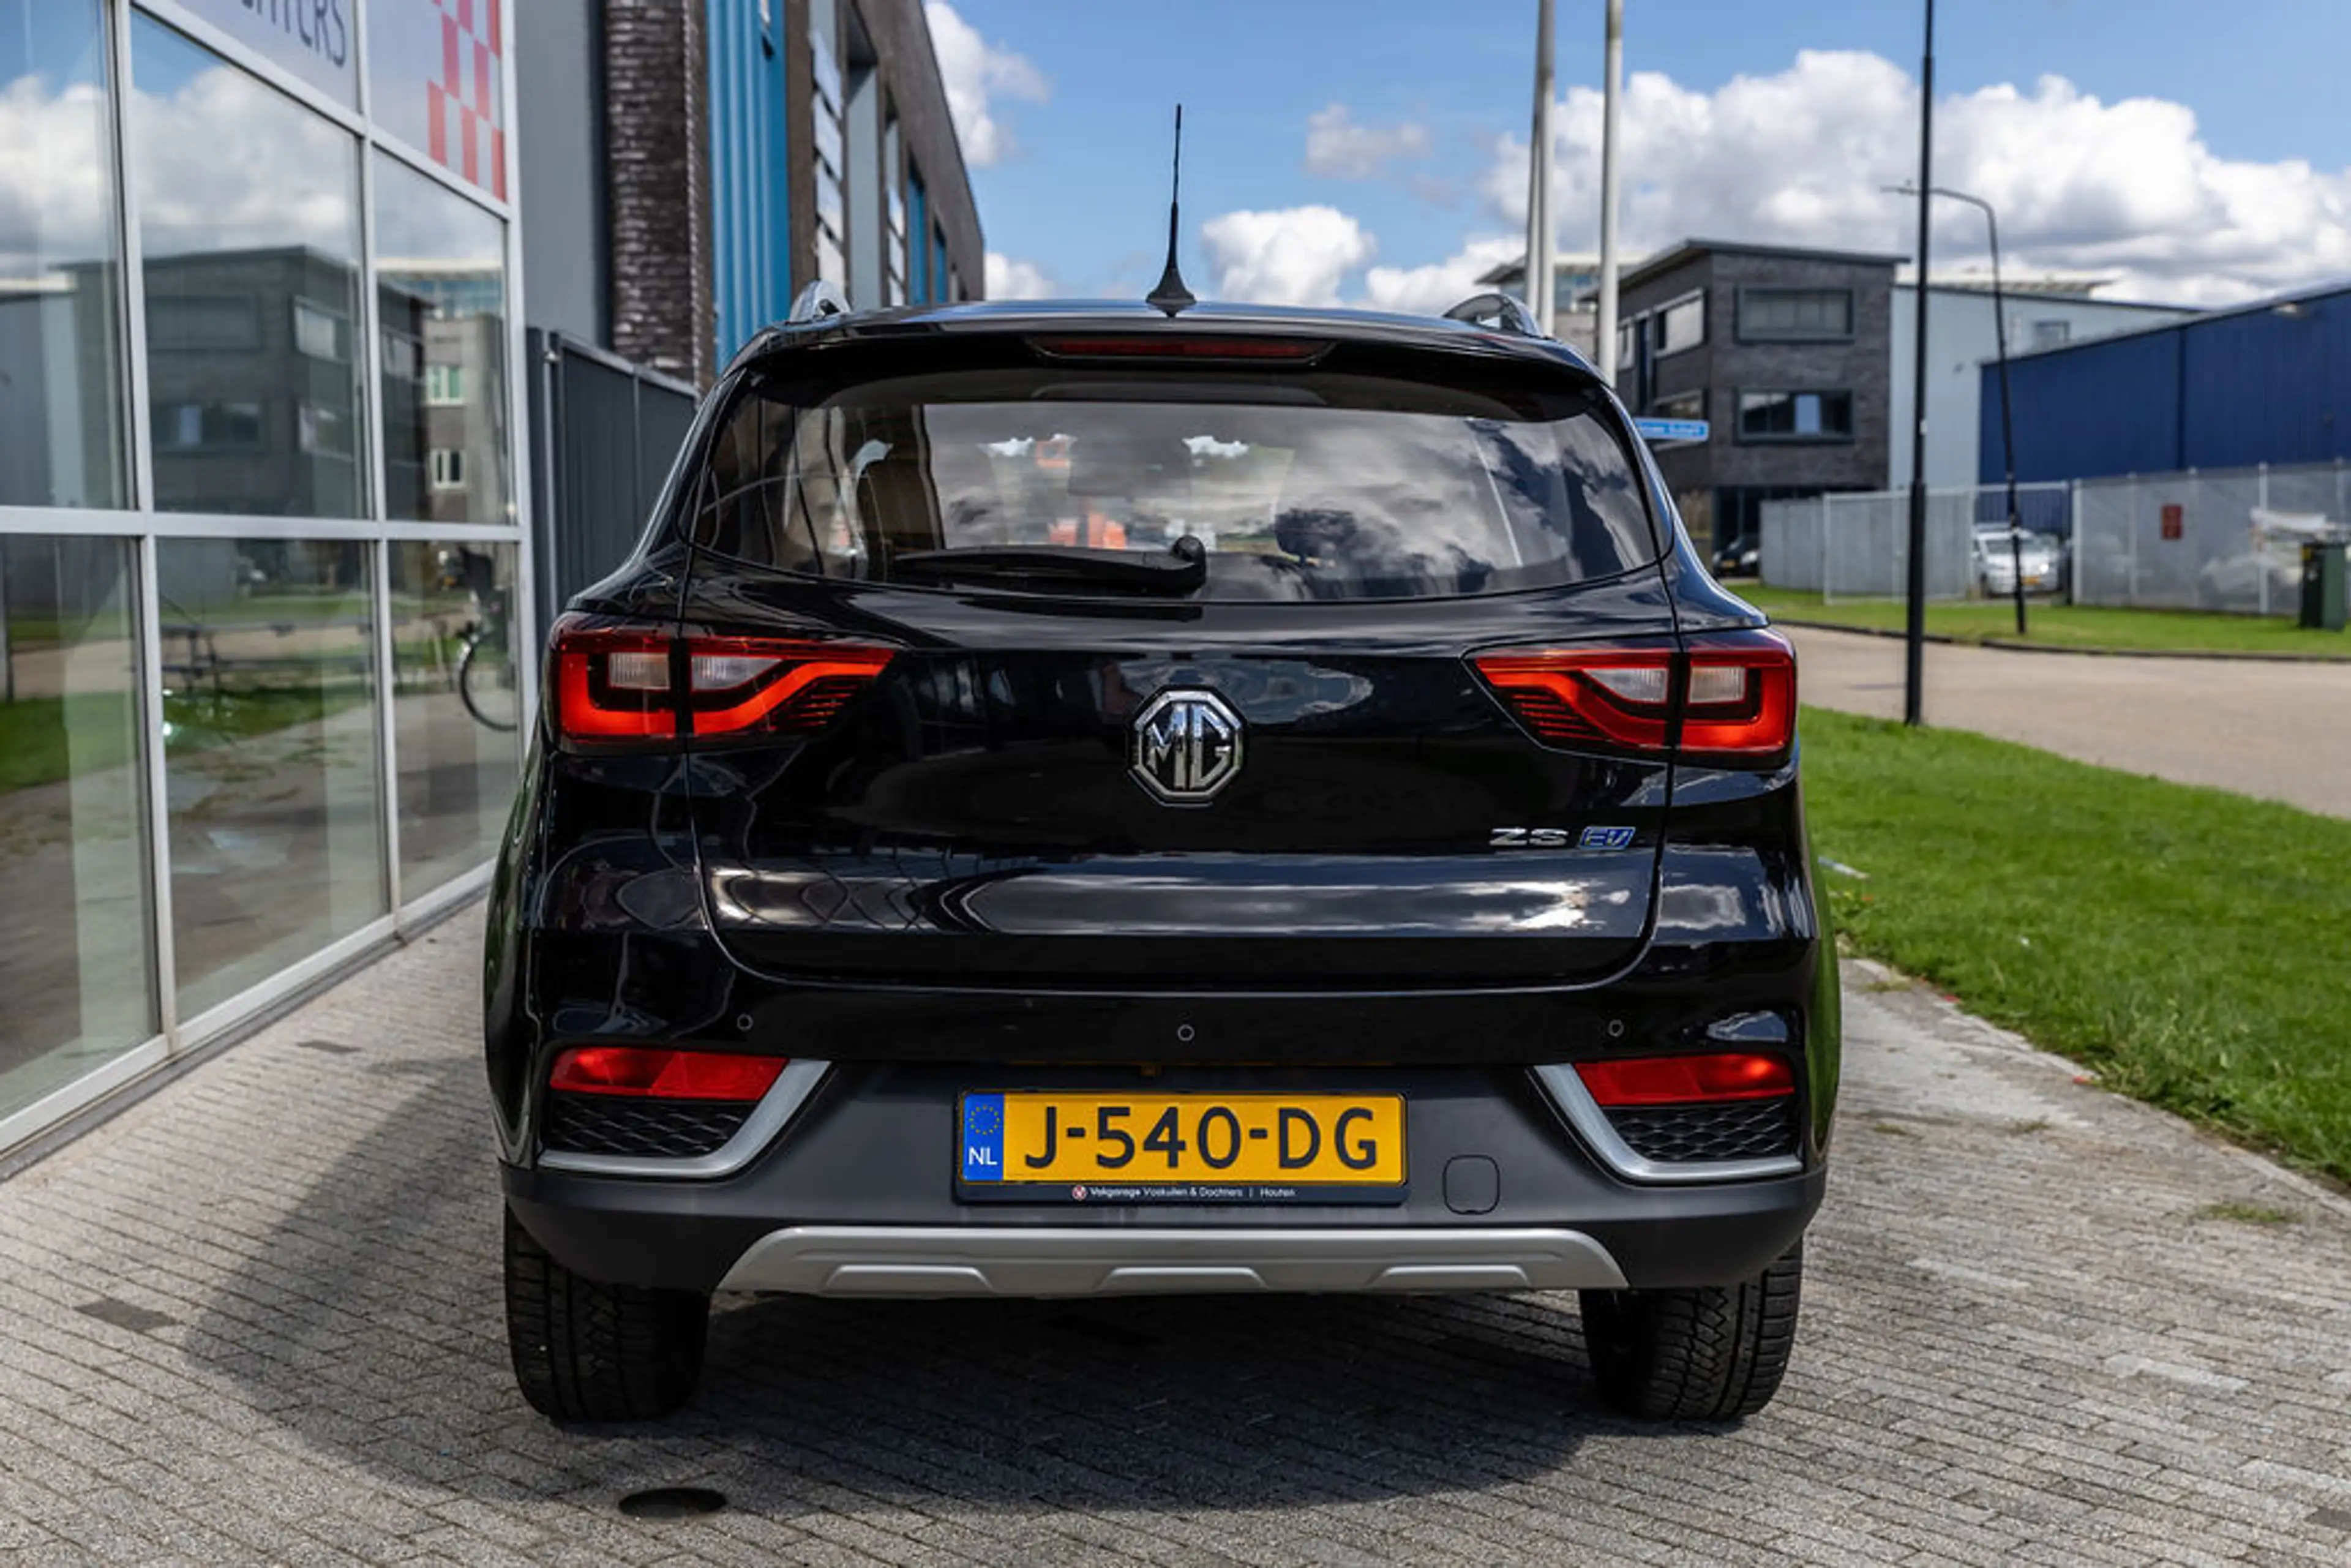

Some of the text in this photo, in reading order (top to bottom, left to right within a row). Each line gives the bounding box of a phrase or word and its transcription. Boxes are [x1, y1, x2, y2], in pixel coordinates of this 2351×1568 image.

[1144, 702, 1232, 791] MG
[1489, 827, 1630, 847] ZS EV
[969, 1146, 998, 1165] NL
[1024, 1106, 1377, 1169] J-540-DG
